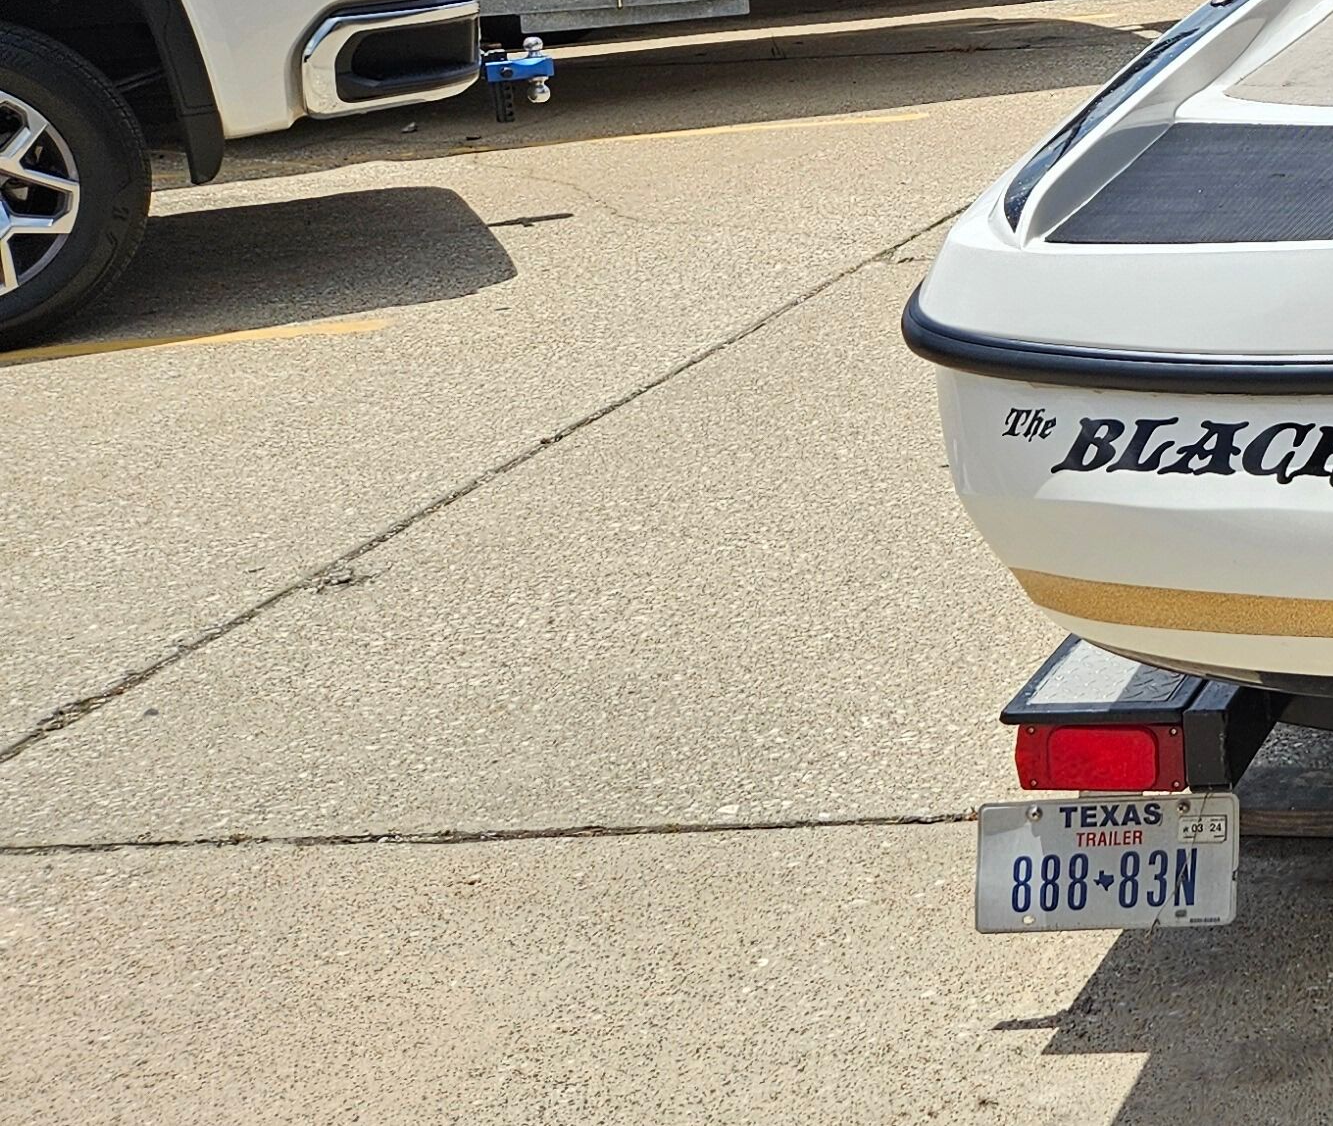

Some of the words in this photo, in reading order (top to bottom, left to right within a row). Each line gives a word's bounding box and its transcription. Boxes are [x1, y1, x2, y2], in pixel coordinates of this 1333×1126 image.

[1001, 407, 1057, 443] The
[1060, 803, 1162, 829] TEXAS
[1209, 822, 1222, 833] 24
[1076, 830, 1143, 847] TRAILER
